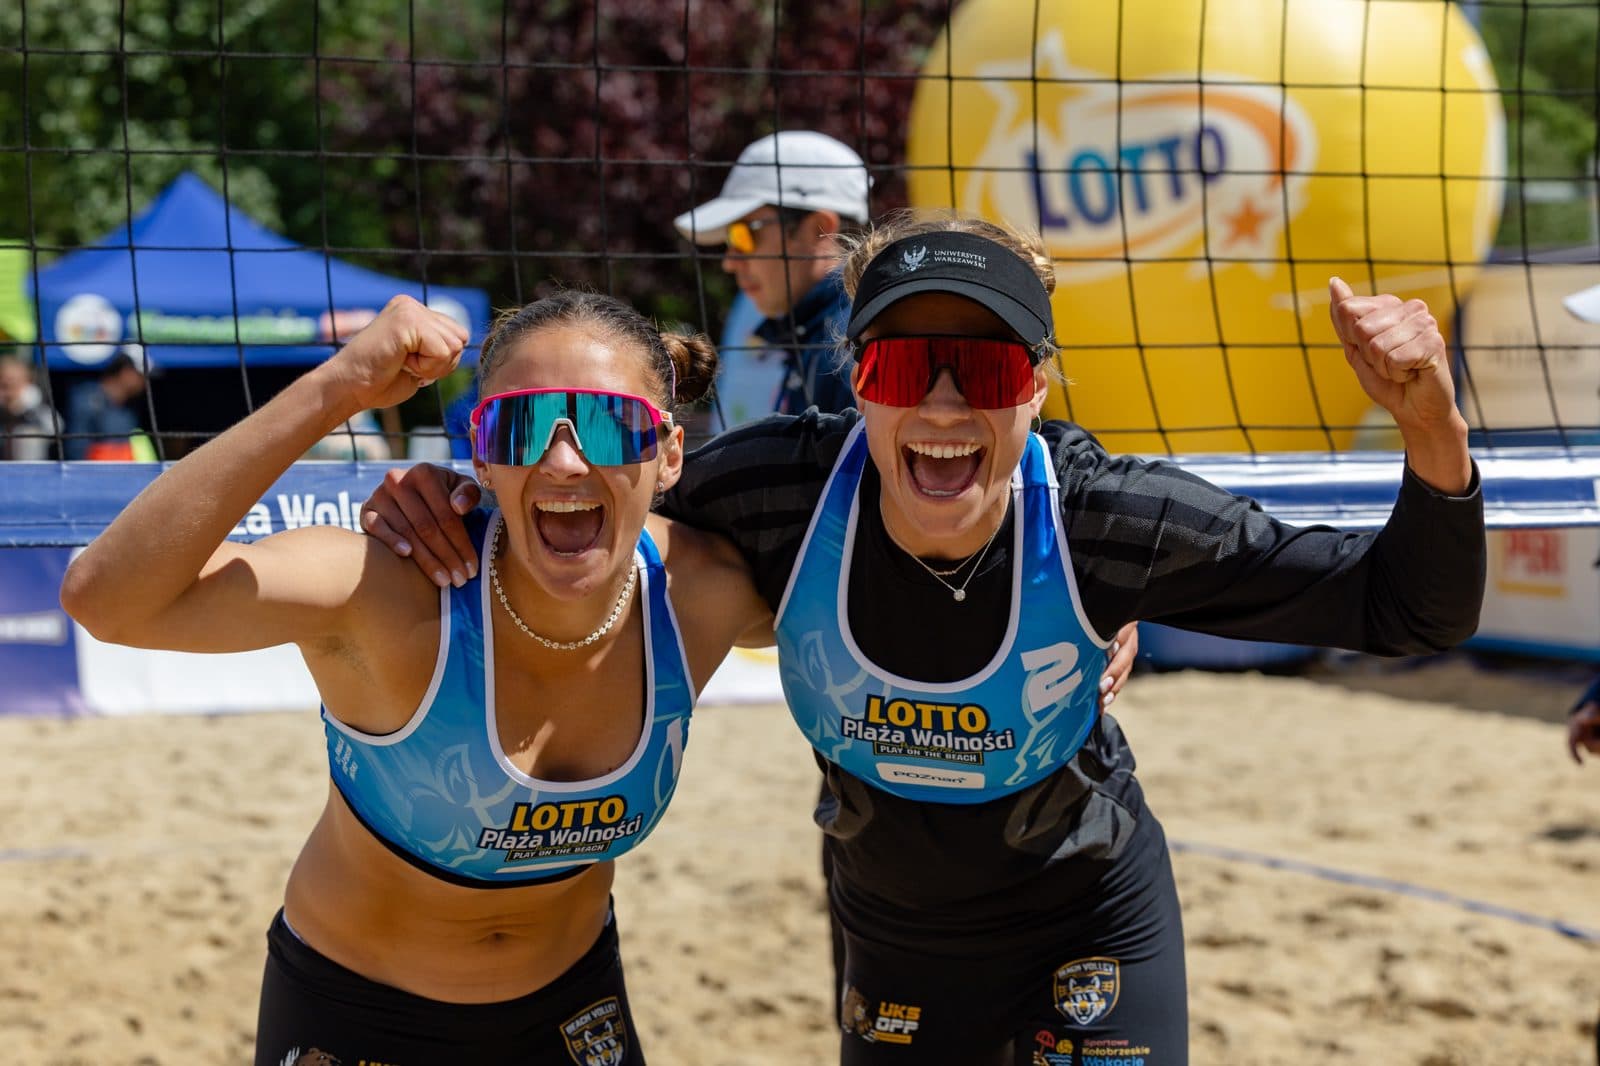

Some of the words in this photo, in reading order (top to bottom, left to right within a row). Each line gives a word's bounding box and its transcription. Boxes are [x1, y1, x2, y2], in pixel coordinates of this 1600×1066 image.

[1025, 126, 1223, 228] LOTTO
[934, 250, 987, 263] UNIWERSYTET
[934, 257, 986, 269] WARSZAWSKI
[1020, 641, 1083, 713] 2
[867, 697, 987, 733] LOTTO
[843, 719, 906, 744] Plaża
[911, 728, 1014, 752] Wolności
[880, 745, 903, 754] PLAY
[945, 753, 977, 762] BEACH
[511, 797, 625, 832] LOTTO
[480, 829, 543, 850] Plaża
[550, 815, 642, 847] Wolności
[513, 851, 536, 859] PLAY
[538, 849, 552, 857] ON
[555, 847, 571, 855] THE
[574, 844, 605, 853] BEACH
[879, 1001, 921, 1020] UKS
